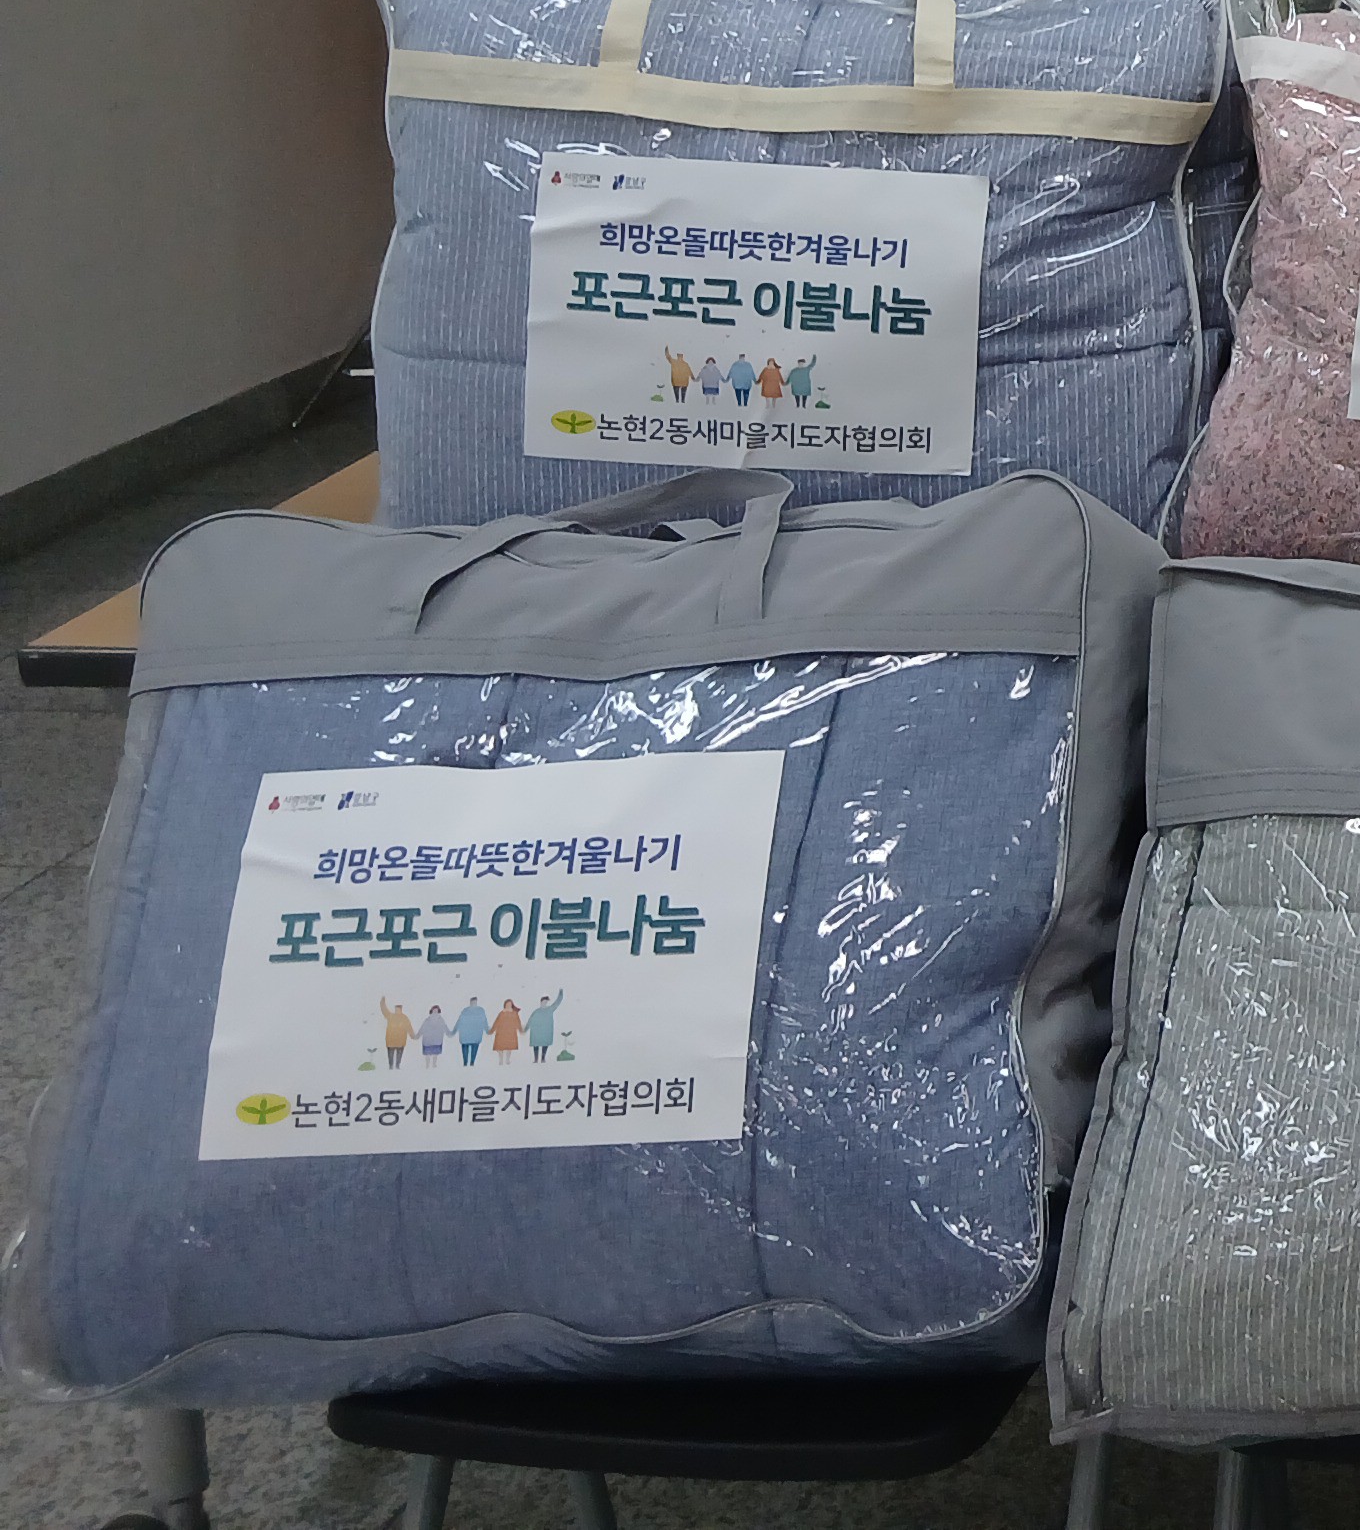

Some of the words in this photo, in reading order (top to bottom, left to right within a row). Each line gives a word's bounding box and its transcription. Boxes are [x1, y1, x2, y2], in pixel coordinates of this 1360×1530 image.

[598, 221, 908, 268] 희망온돌따뜻한겨울나기
[567, 271, 743, 326] 포근포근
[754, 281, 932, 335] 이불나눔
[595, 414, 931, 453] 논현2동새마을지도자협의회
[314, 834, 681, 884] 희망온돌따뜻한겨울나기
[269, 904, 477, 967] 포근포근
[490, 894, 705, 960] 이불나눔
[290, 1077, 694, 1128] 논현2동새마을지도자협의회
